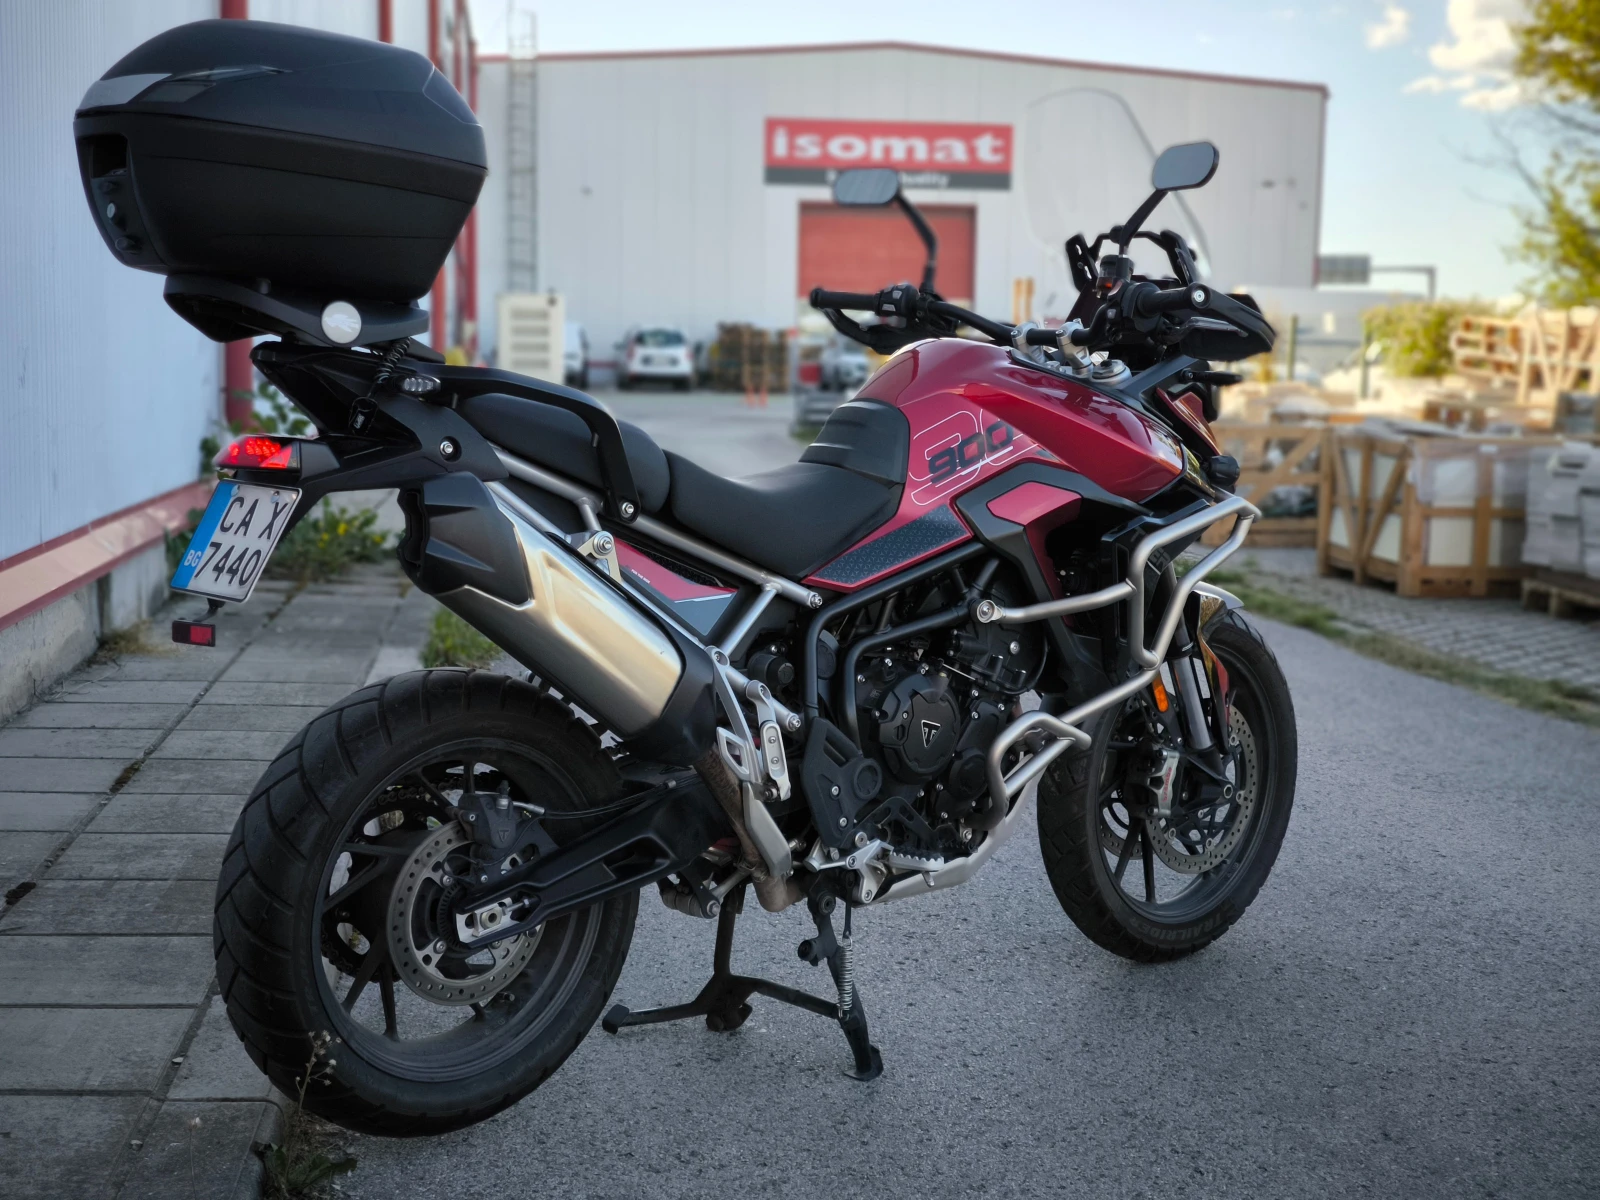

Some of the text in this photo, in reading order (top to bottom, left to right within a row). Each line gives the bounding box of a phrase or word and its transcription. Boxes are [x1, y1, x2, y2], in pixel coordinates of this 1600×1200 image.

[772, 126, 1005, 164] isomat
[928, 420, 1014, 484] 900
[219, 496, 289, 540] CA X
[183, 549, 202, 567] BG
[194, 541, 262, 587] 7440
